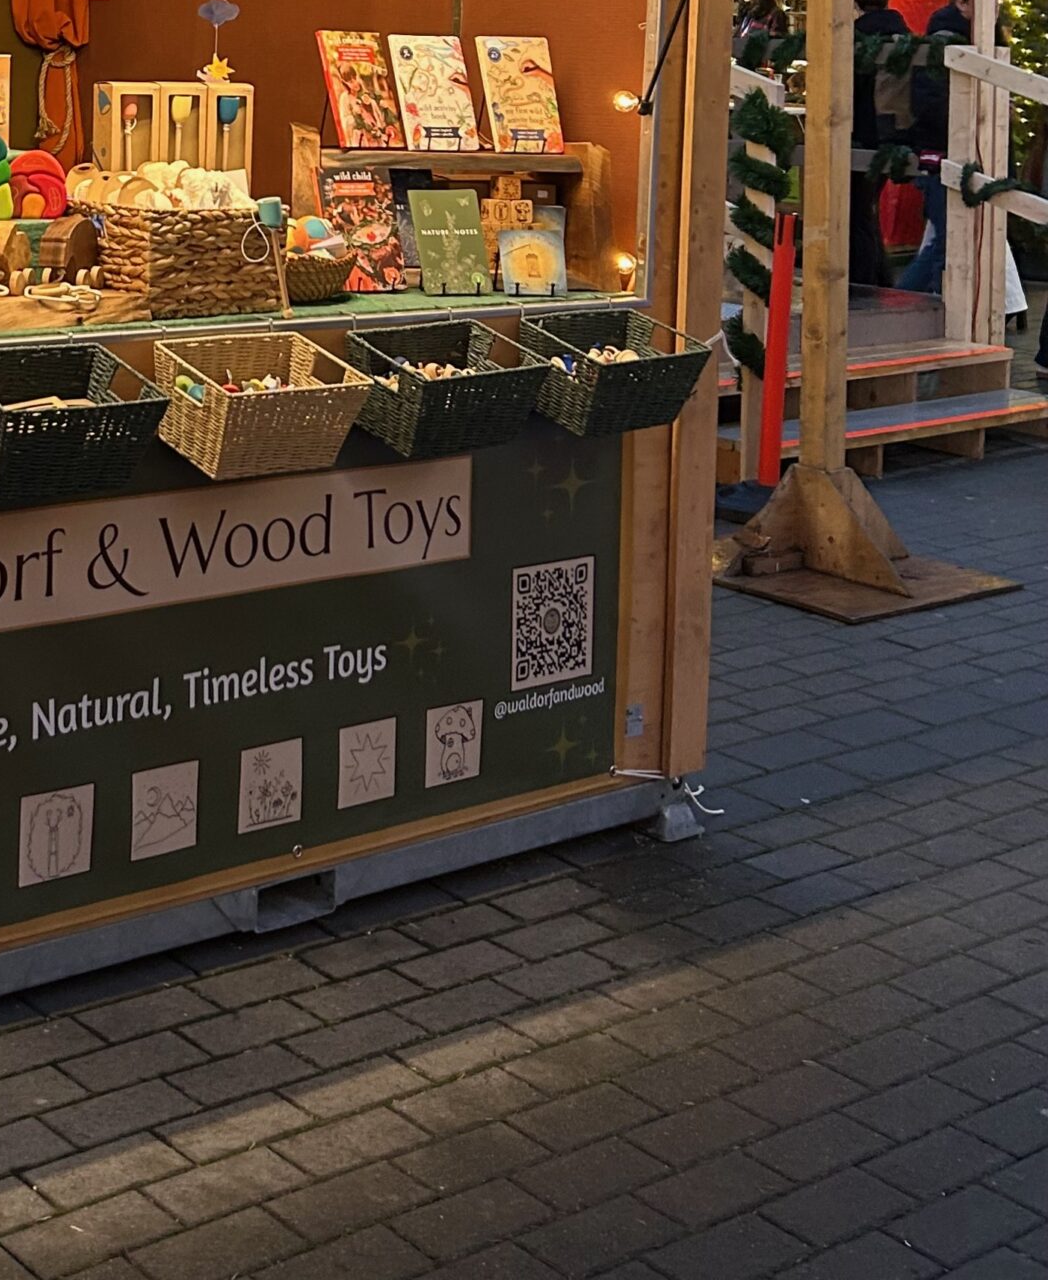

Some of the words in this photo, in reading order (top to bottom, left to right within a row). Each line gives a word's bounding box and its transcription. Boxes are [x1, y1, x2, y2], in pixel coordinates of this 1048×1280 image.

[333, 170, 351, 181] wild
[352, 170, 372, 181] child
[420, 228, 449, 236] NATURE
[454, 228, 478, 236] NOTES
[87, 522, 150, 597] &
[158, 493, 334, 578] Wood
[354, 488, 462, 560] Toys
[30, 678, 173, 740] Natural,
[182, 654, 315, 710] Timeless
[323, 642, 389, 690] Toys
[494, 677, 605, 719] @waldorfandwood
